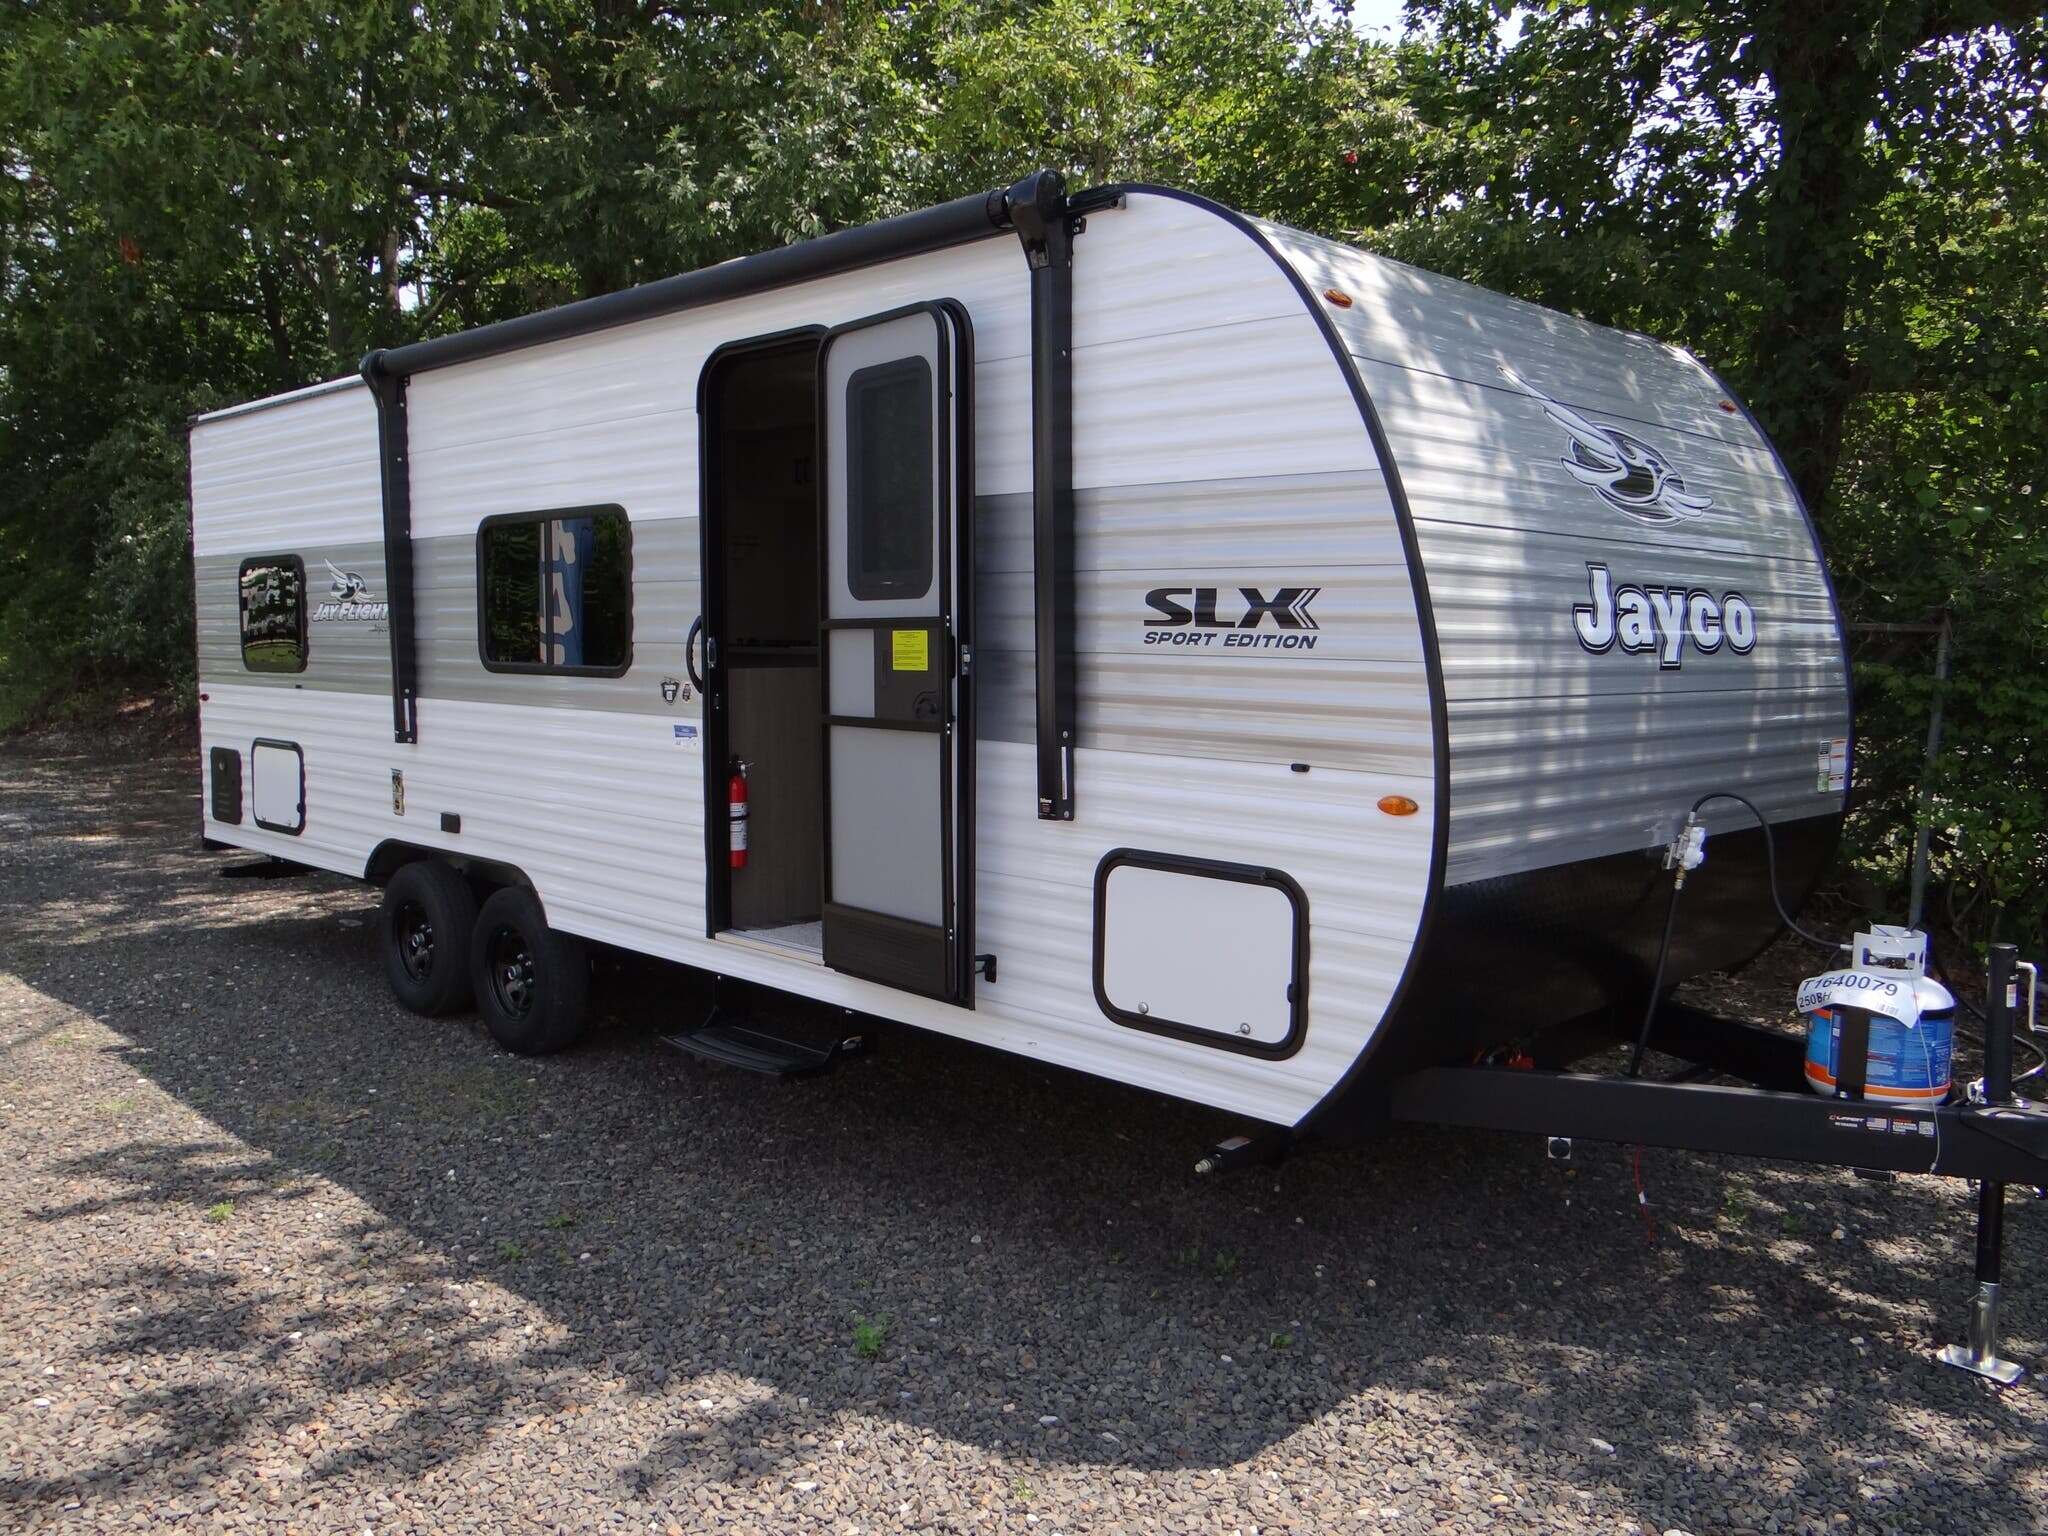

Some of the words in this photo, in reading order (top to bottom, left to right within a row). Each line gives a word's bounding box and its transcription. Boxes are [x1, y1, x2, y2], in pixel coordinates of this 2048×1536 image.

[312, 602, 340, 622] JAY
[1144, 587, 1322, 630] SLX
[1572, 561, 1757, 671] Jayco
[1143, 631, 1217, 647] SPORT
[1223, 633, 1319, 650] EDITION
[1803, 974, 1898, 997] T1640079
[1798, 991, 1832, 1009] 250BH
